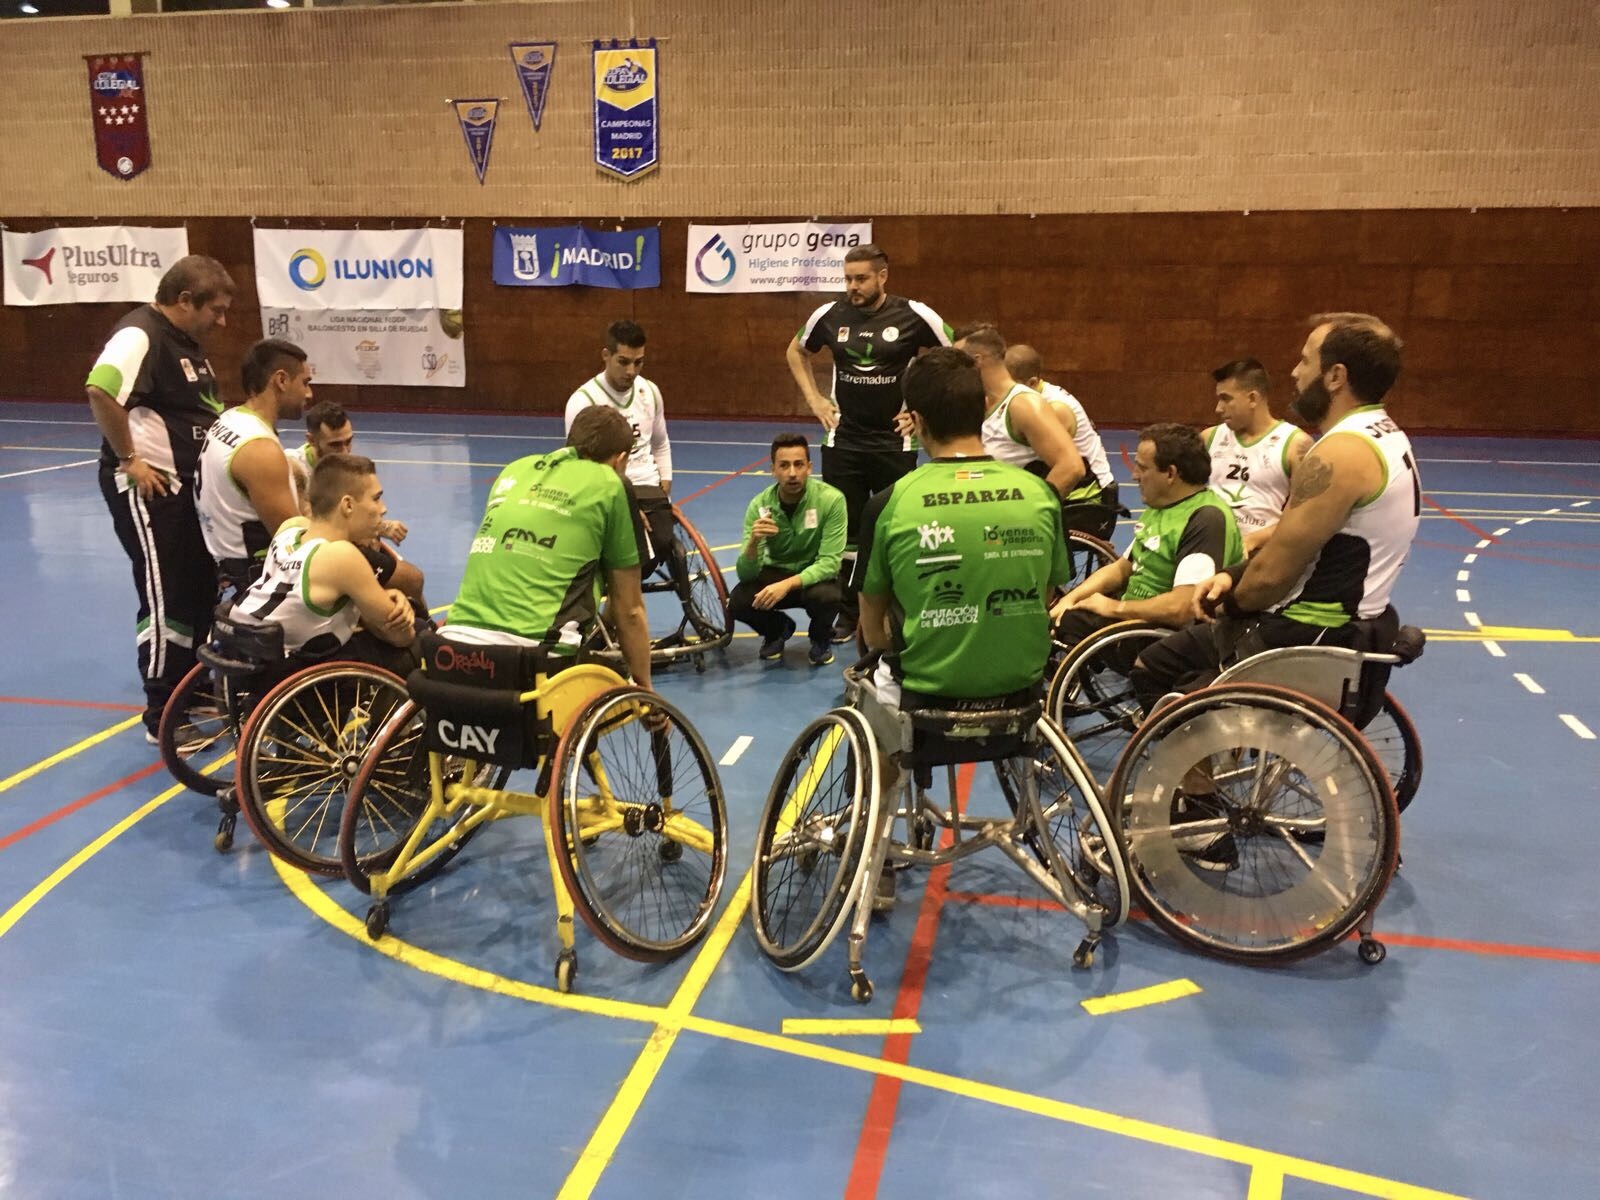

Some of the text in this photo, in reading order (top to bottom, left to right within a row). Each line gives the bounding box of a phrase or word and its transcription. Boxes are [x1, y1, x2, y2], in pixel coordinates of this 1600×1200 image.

[600, 119, 652, 128] CAMPEONAS
[611, 132, 643, 140] MADRID
[611, 147, 643, 160] 2017
[742, 232, 860, 253] grupo gena
[62, 245, 162, 269] PlusUltra
[748, 257, 845, 271] Higiene Profesion
[334, 258, 433, 280] ILUNION
[308, 324, 356, 332] BALONCESTO
[1226, 464, 1250, 482] 26
[922, 487, 1024, 507] ESPARZA
[932, 614, 978, 628] BADAJOZ
[438, 719, 500, 755] CAY
